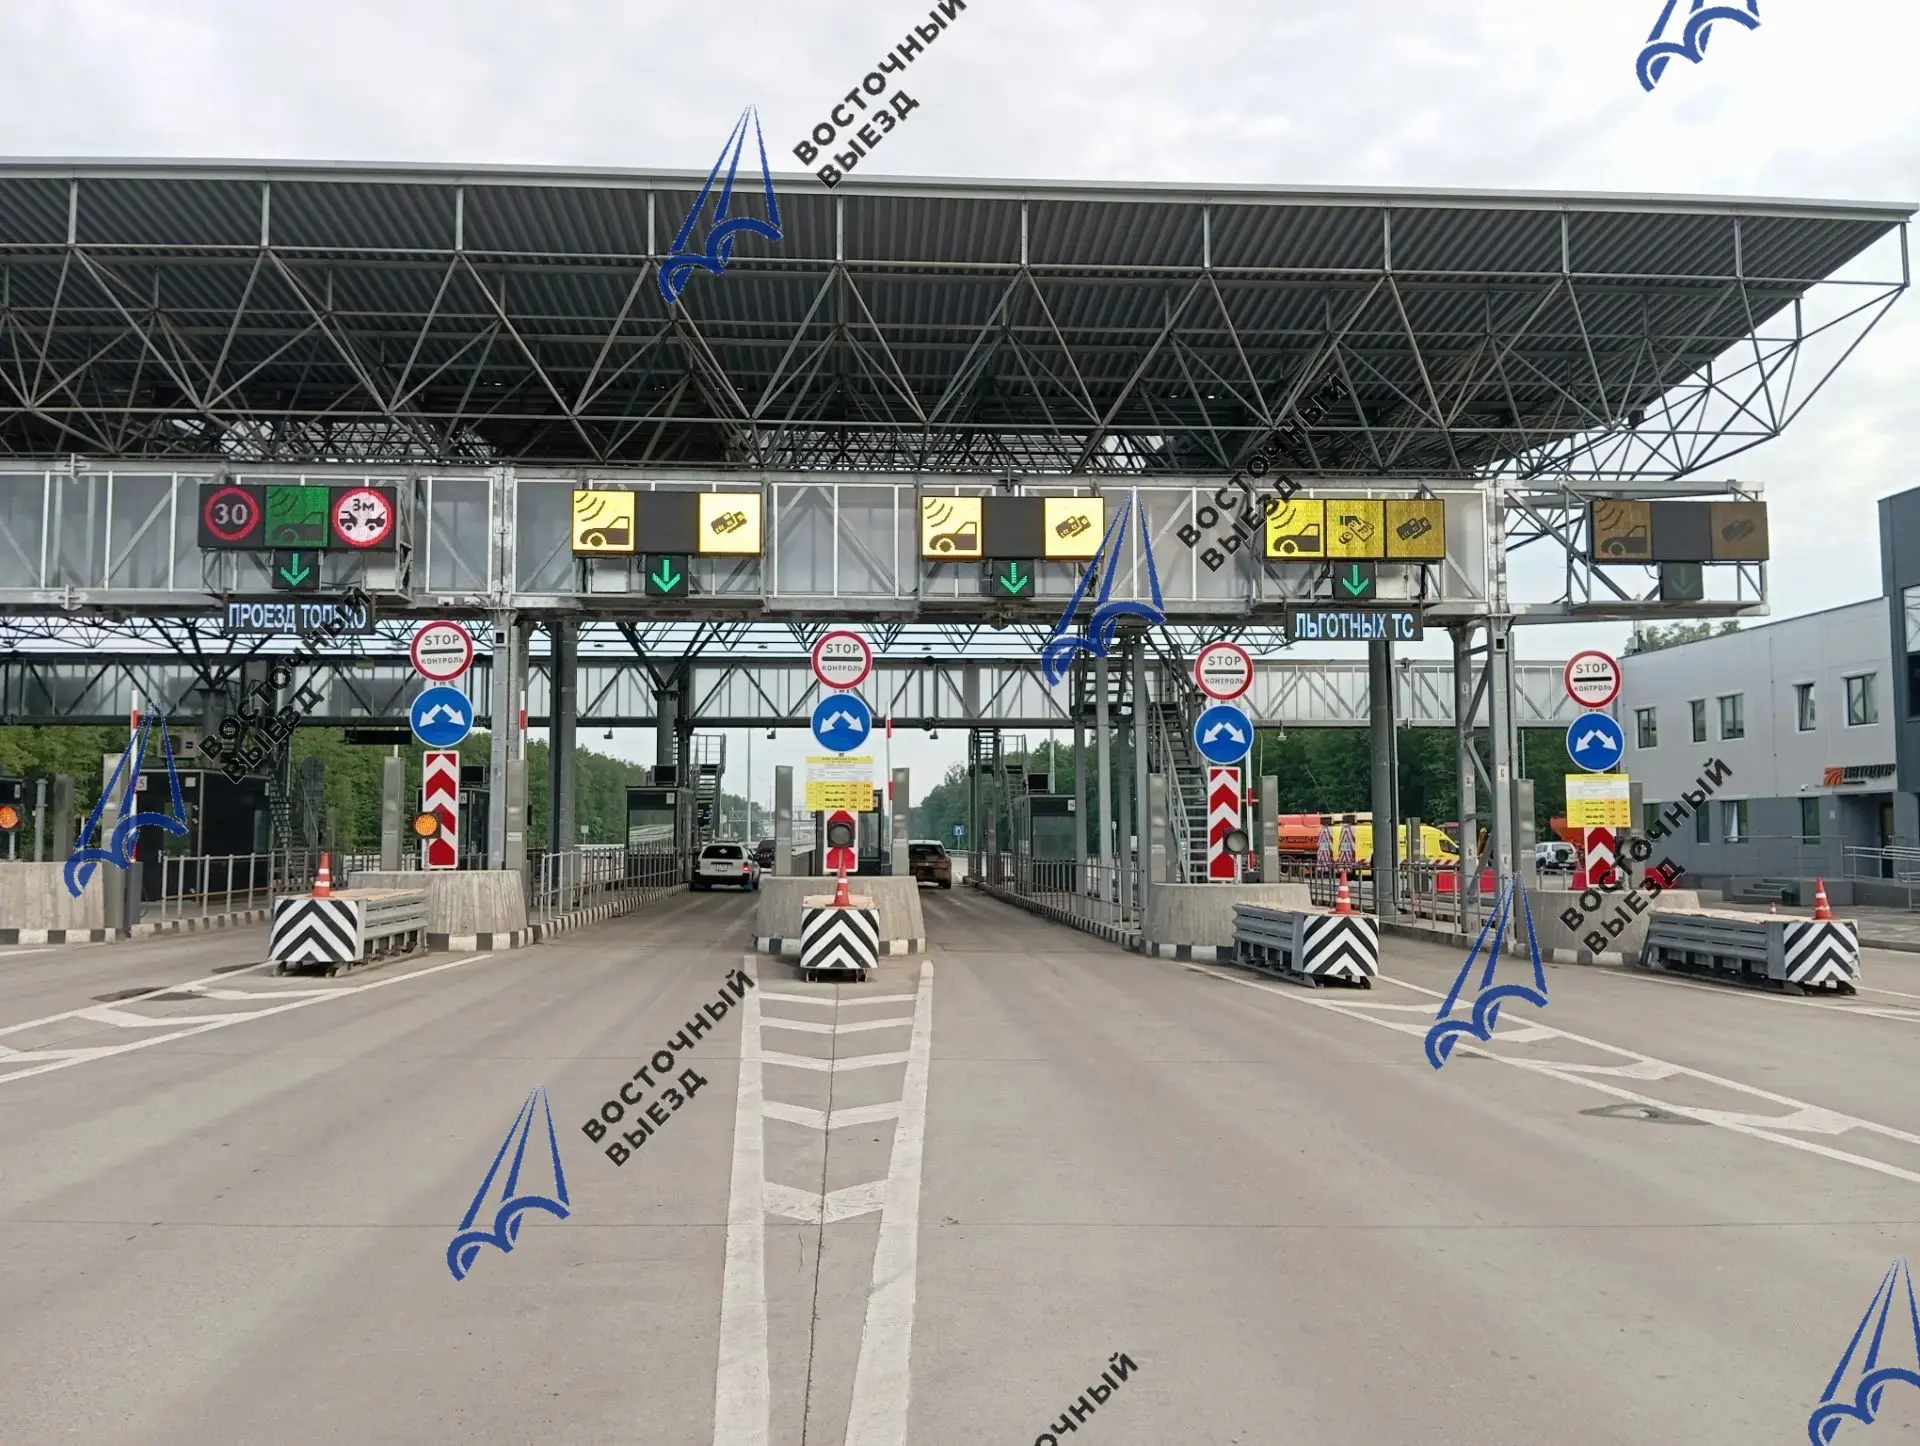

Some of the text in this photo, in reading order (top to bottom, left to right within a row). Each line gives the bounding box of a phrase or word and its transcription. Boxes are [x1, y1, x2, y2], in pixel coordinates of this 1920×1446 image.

[215, 503, 248, 525] 30
[228, 603, 296, 633] ПРОЕЗД
[1294, 613, 1415, 638] ЛЬГОТНЫХ ТС
[424, 634, 460, 646] STOP
[825, 643, 860, 654] STOP
[421, 656, 464, 665] КОНТРОЛЬ
[1208, 656, 1241, 667] STOP
[1576, 663, 1608, 674] STOP
[1574, 684, 1612, 692] КОНТРОЛЬ
